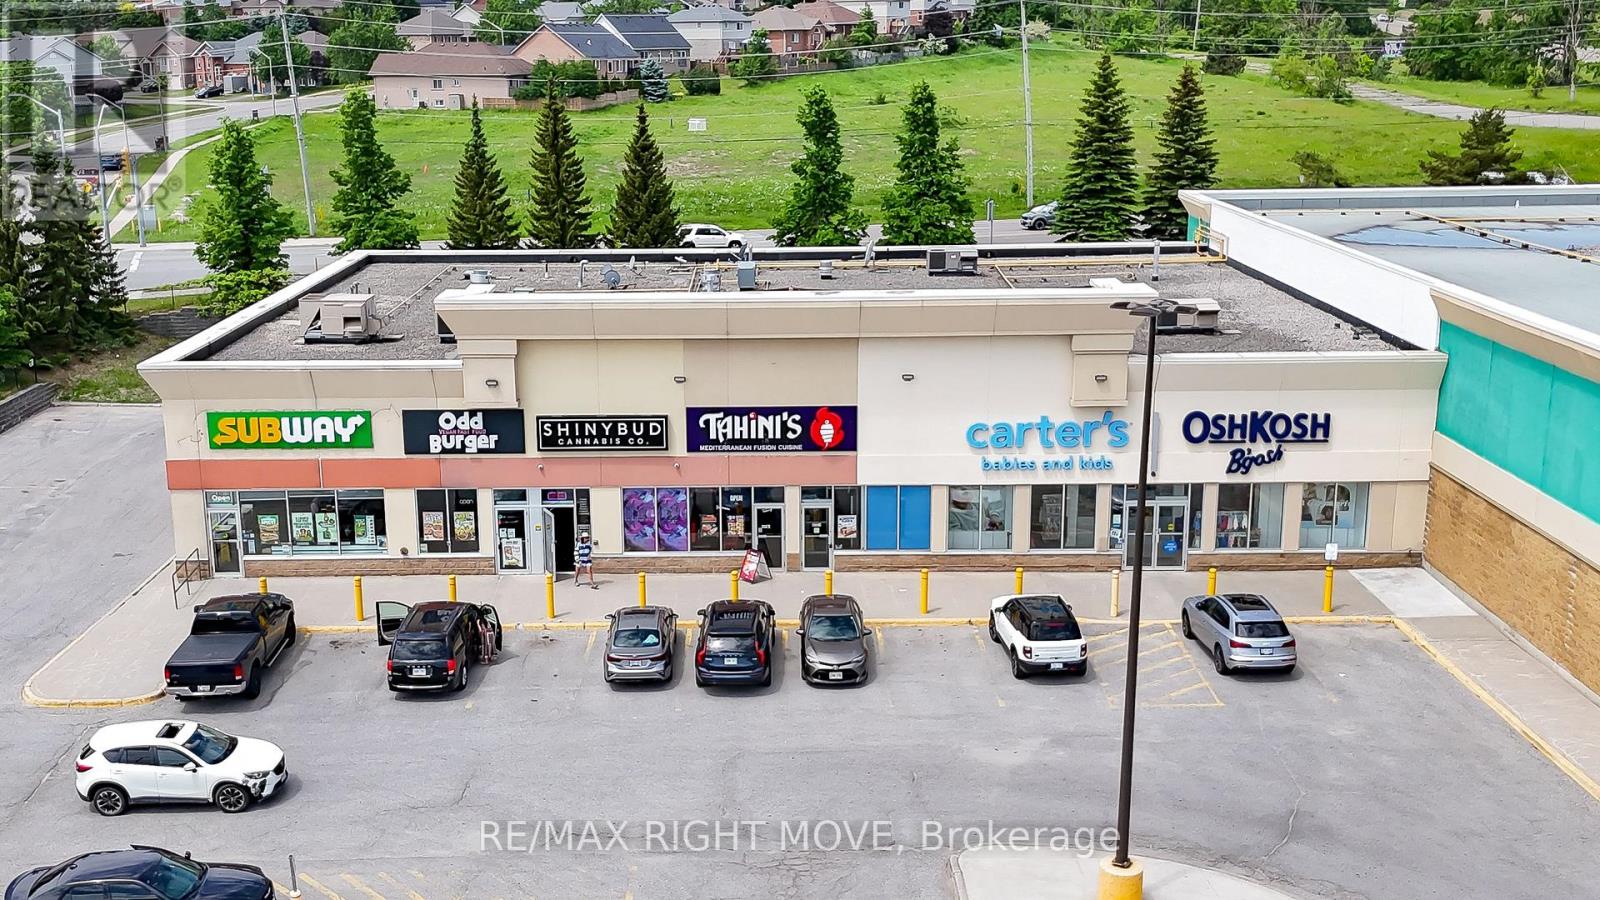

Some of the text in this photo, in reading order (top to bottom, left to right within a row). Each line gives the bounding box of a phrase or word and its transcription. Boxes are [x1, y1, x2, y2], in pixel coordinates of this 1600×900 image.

[438, 411, 484, 430] Odd
[212, 414, 365, 446] SUBWAY
[543, 422, 662, 437] SHINYBUD
[966, 410, 1130, 449] carter's
[558, 437, 650, 445] CANNABIS CO.
[981, 455, 1114, 471] babies and kids
